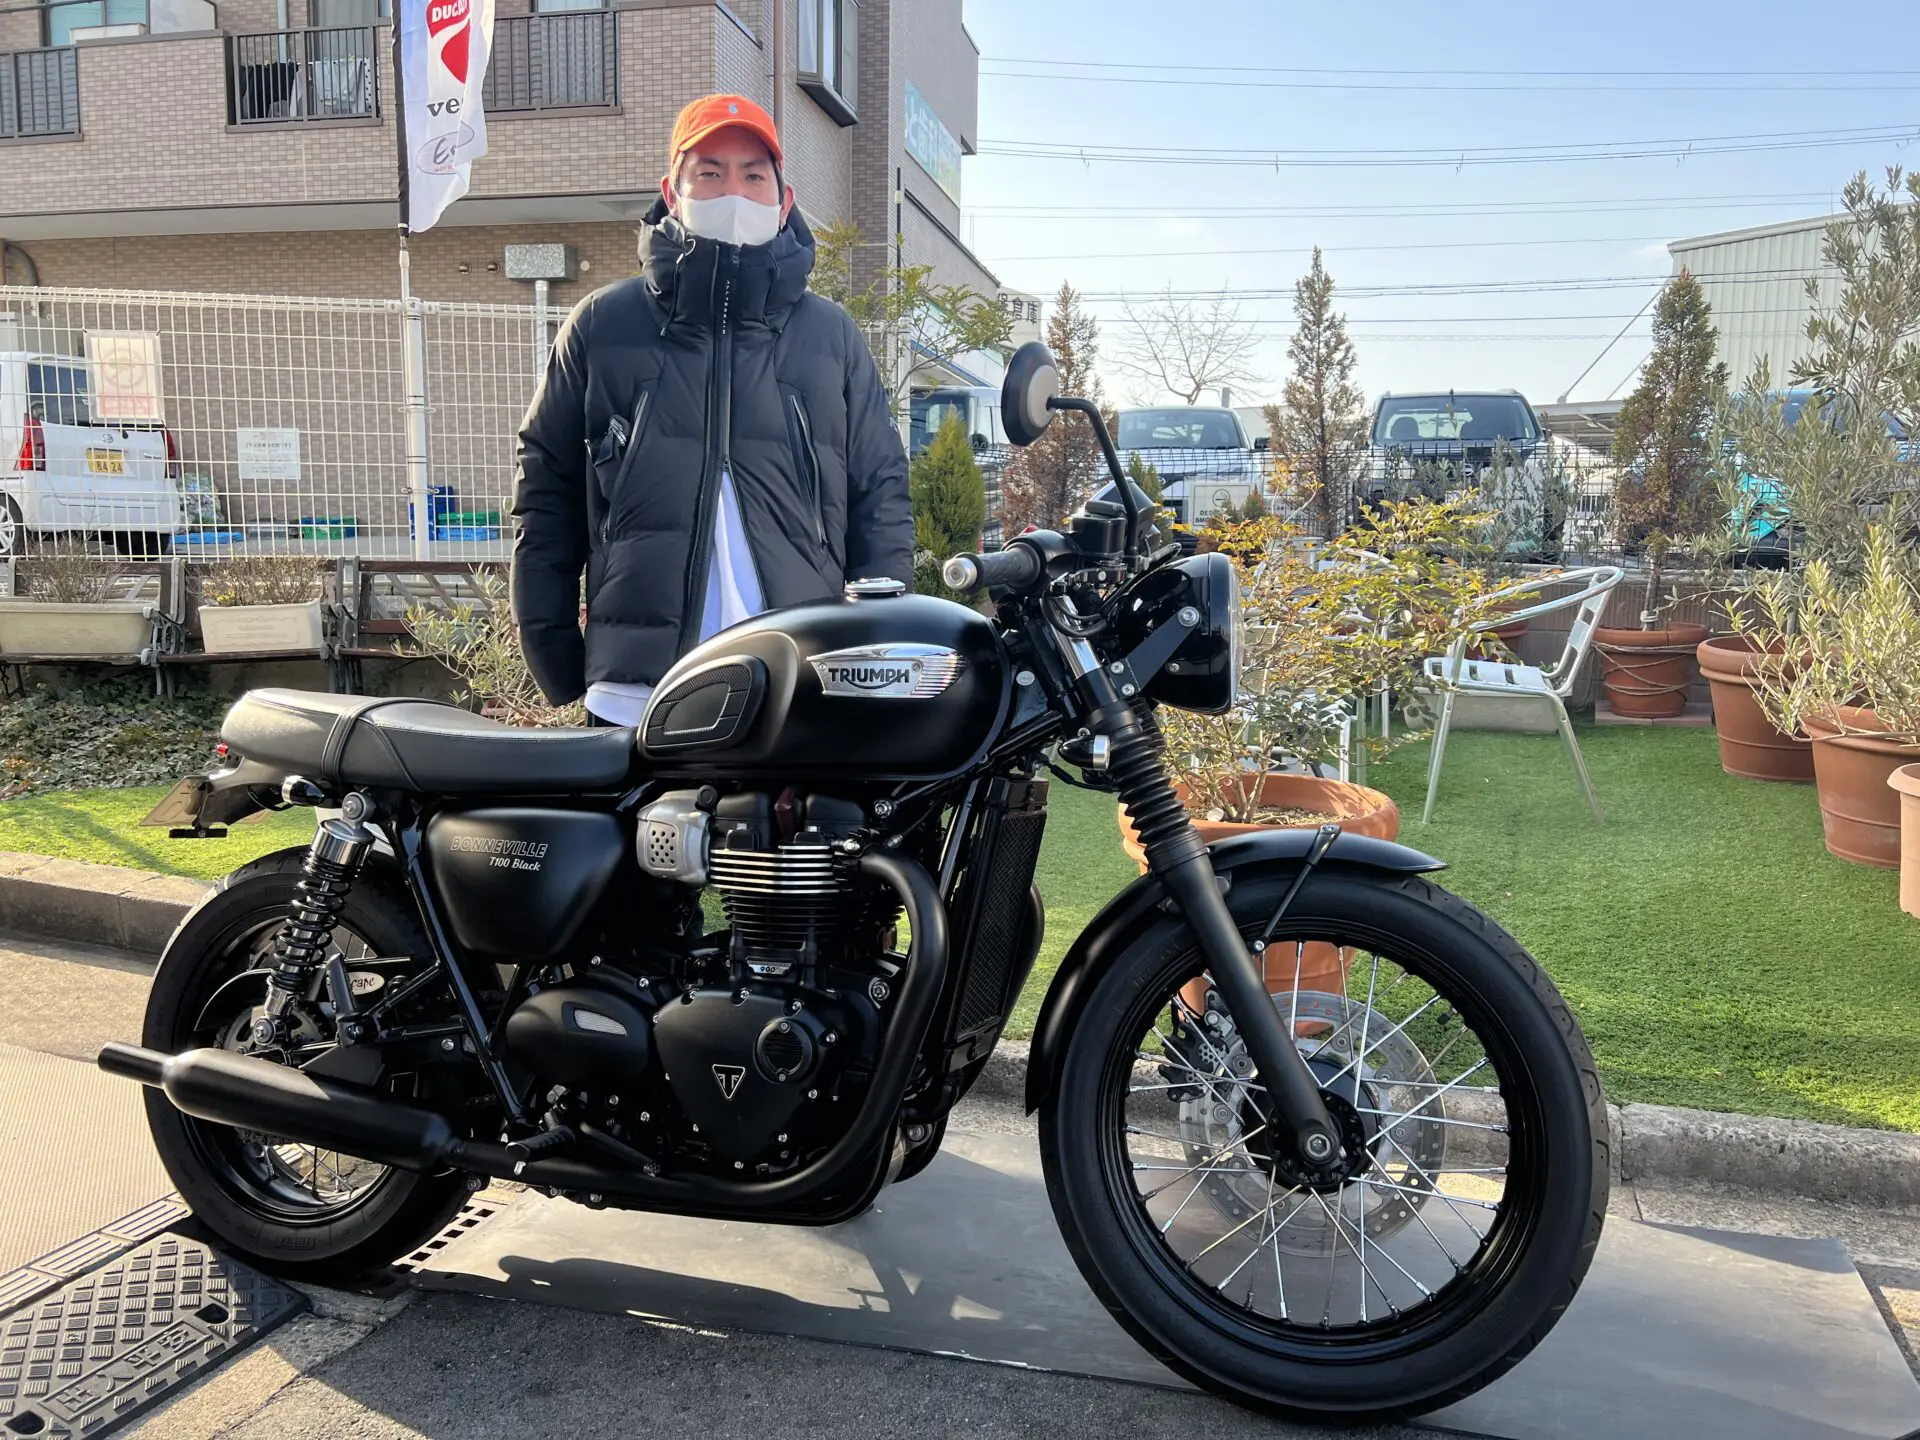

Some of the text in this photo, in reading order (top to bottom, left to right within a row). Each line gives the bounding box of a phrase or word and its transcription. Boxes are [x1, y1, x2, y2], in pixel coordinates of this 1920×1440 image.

[426, 97, 463, 117] ve
[828, 667, 910, 689] TRIUMPH
[450, 836, 549, 858] BONNEVILLE
[489, 856, 541, 872] T100 Black
[760, 965, 776, 974] 900
[56, 1328, 198, 1412] 出入平安
